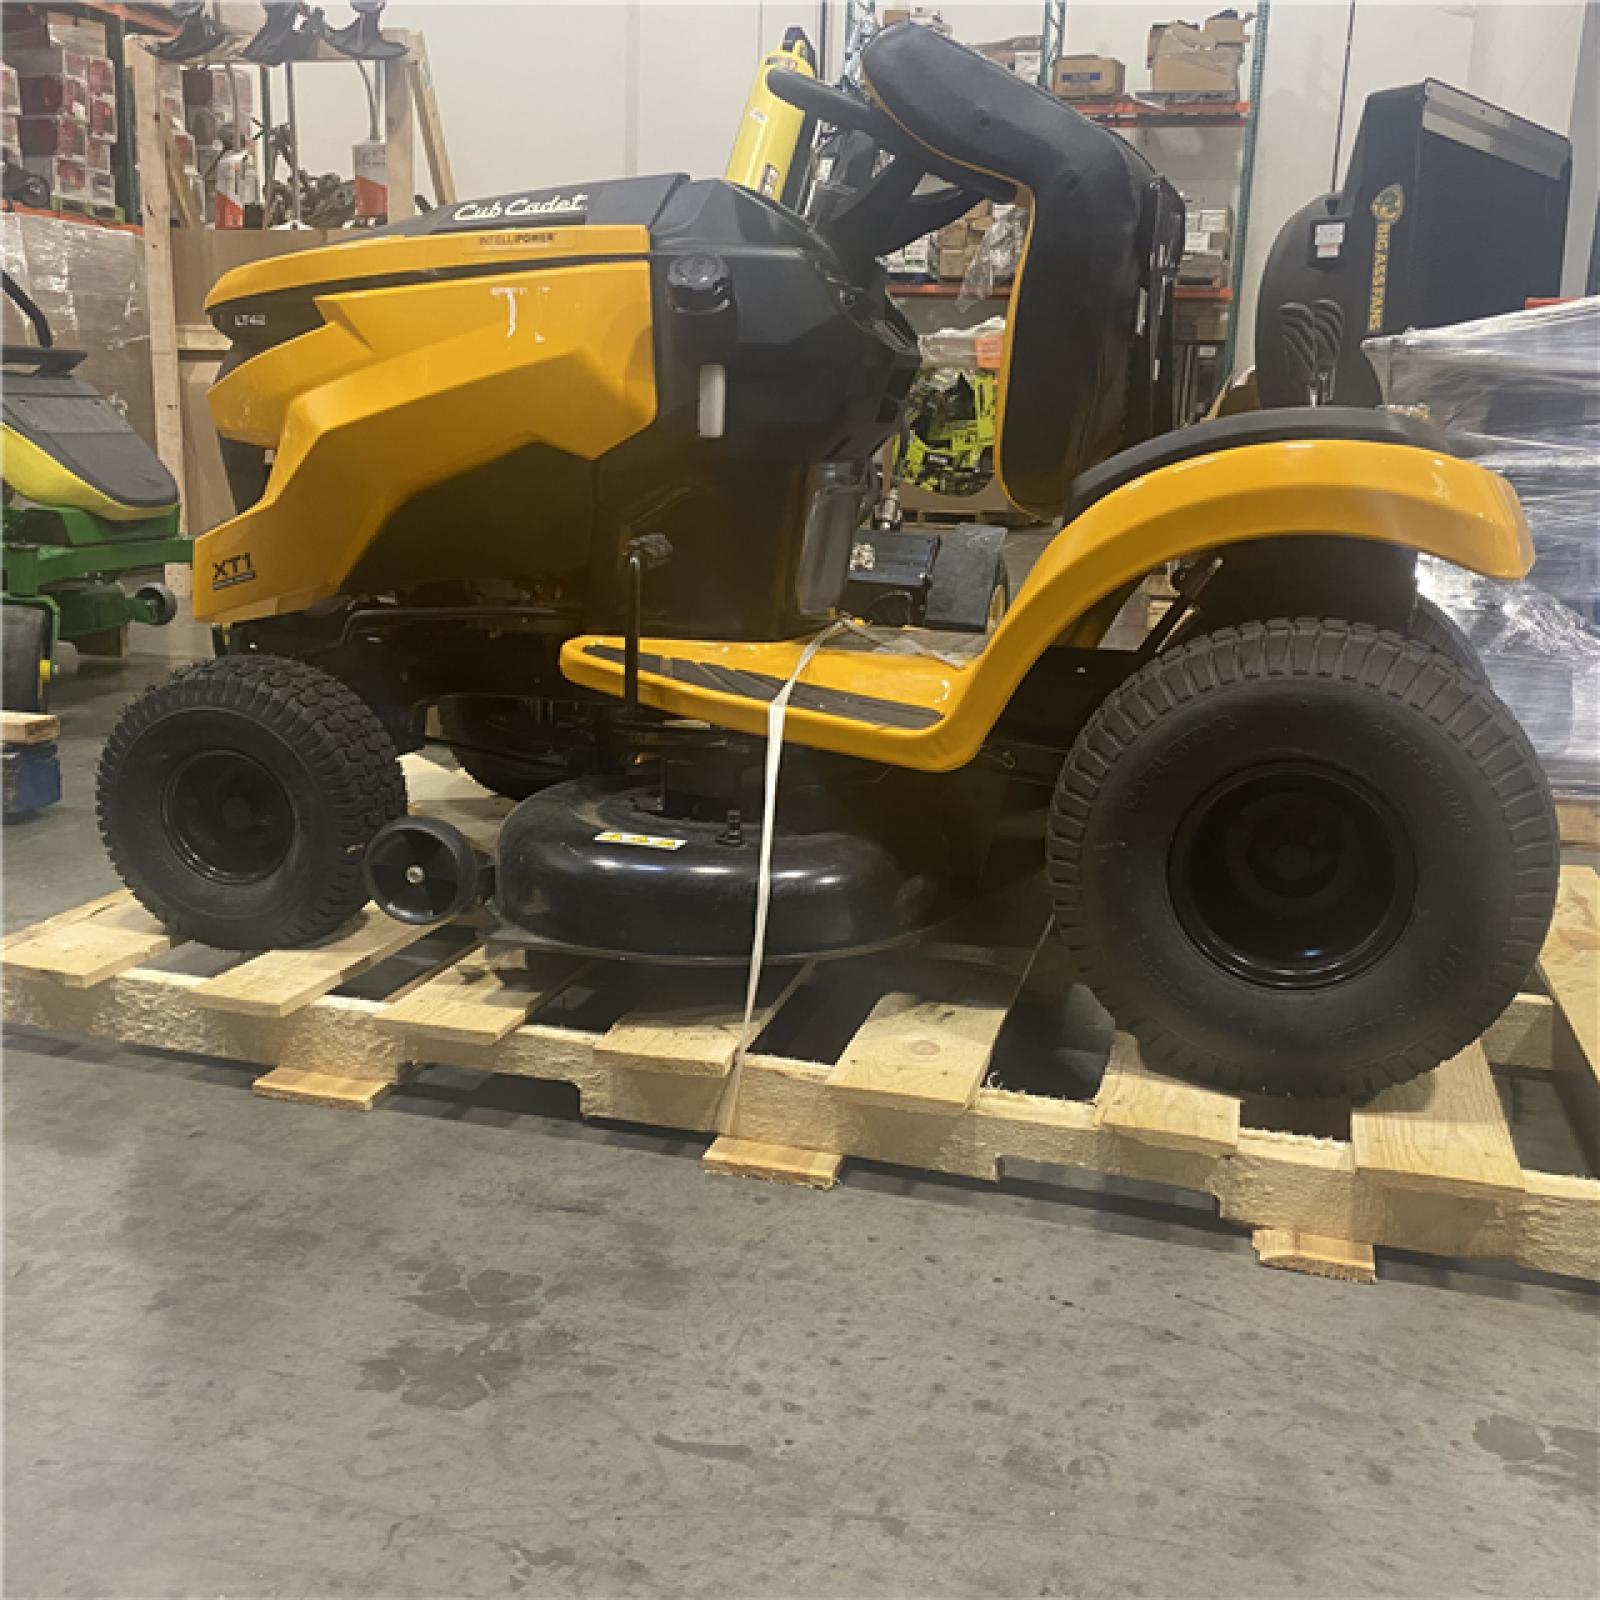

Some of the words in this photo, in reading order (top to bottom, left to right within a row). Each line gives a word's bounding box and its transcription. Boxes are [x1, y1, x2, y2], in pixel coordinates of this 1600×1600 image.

[453, 201, 502, 221] Cub
[504, 193, 588, 216] Cadet
[1375, 223, 1390, 251] BIG
[212, 552, 251, 579] XT1
